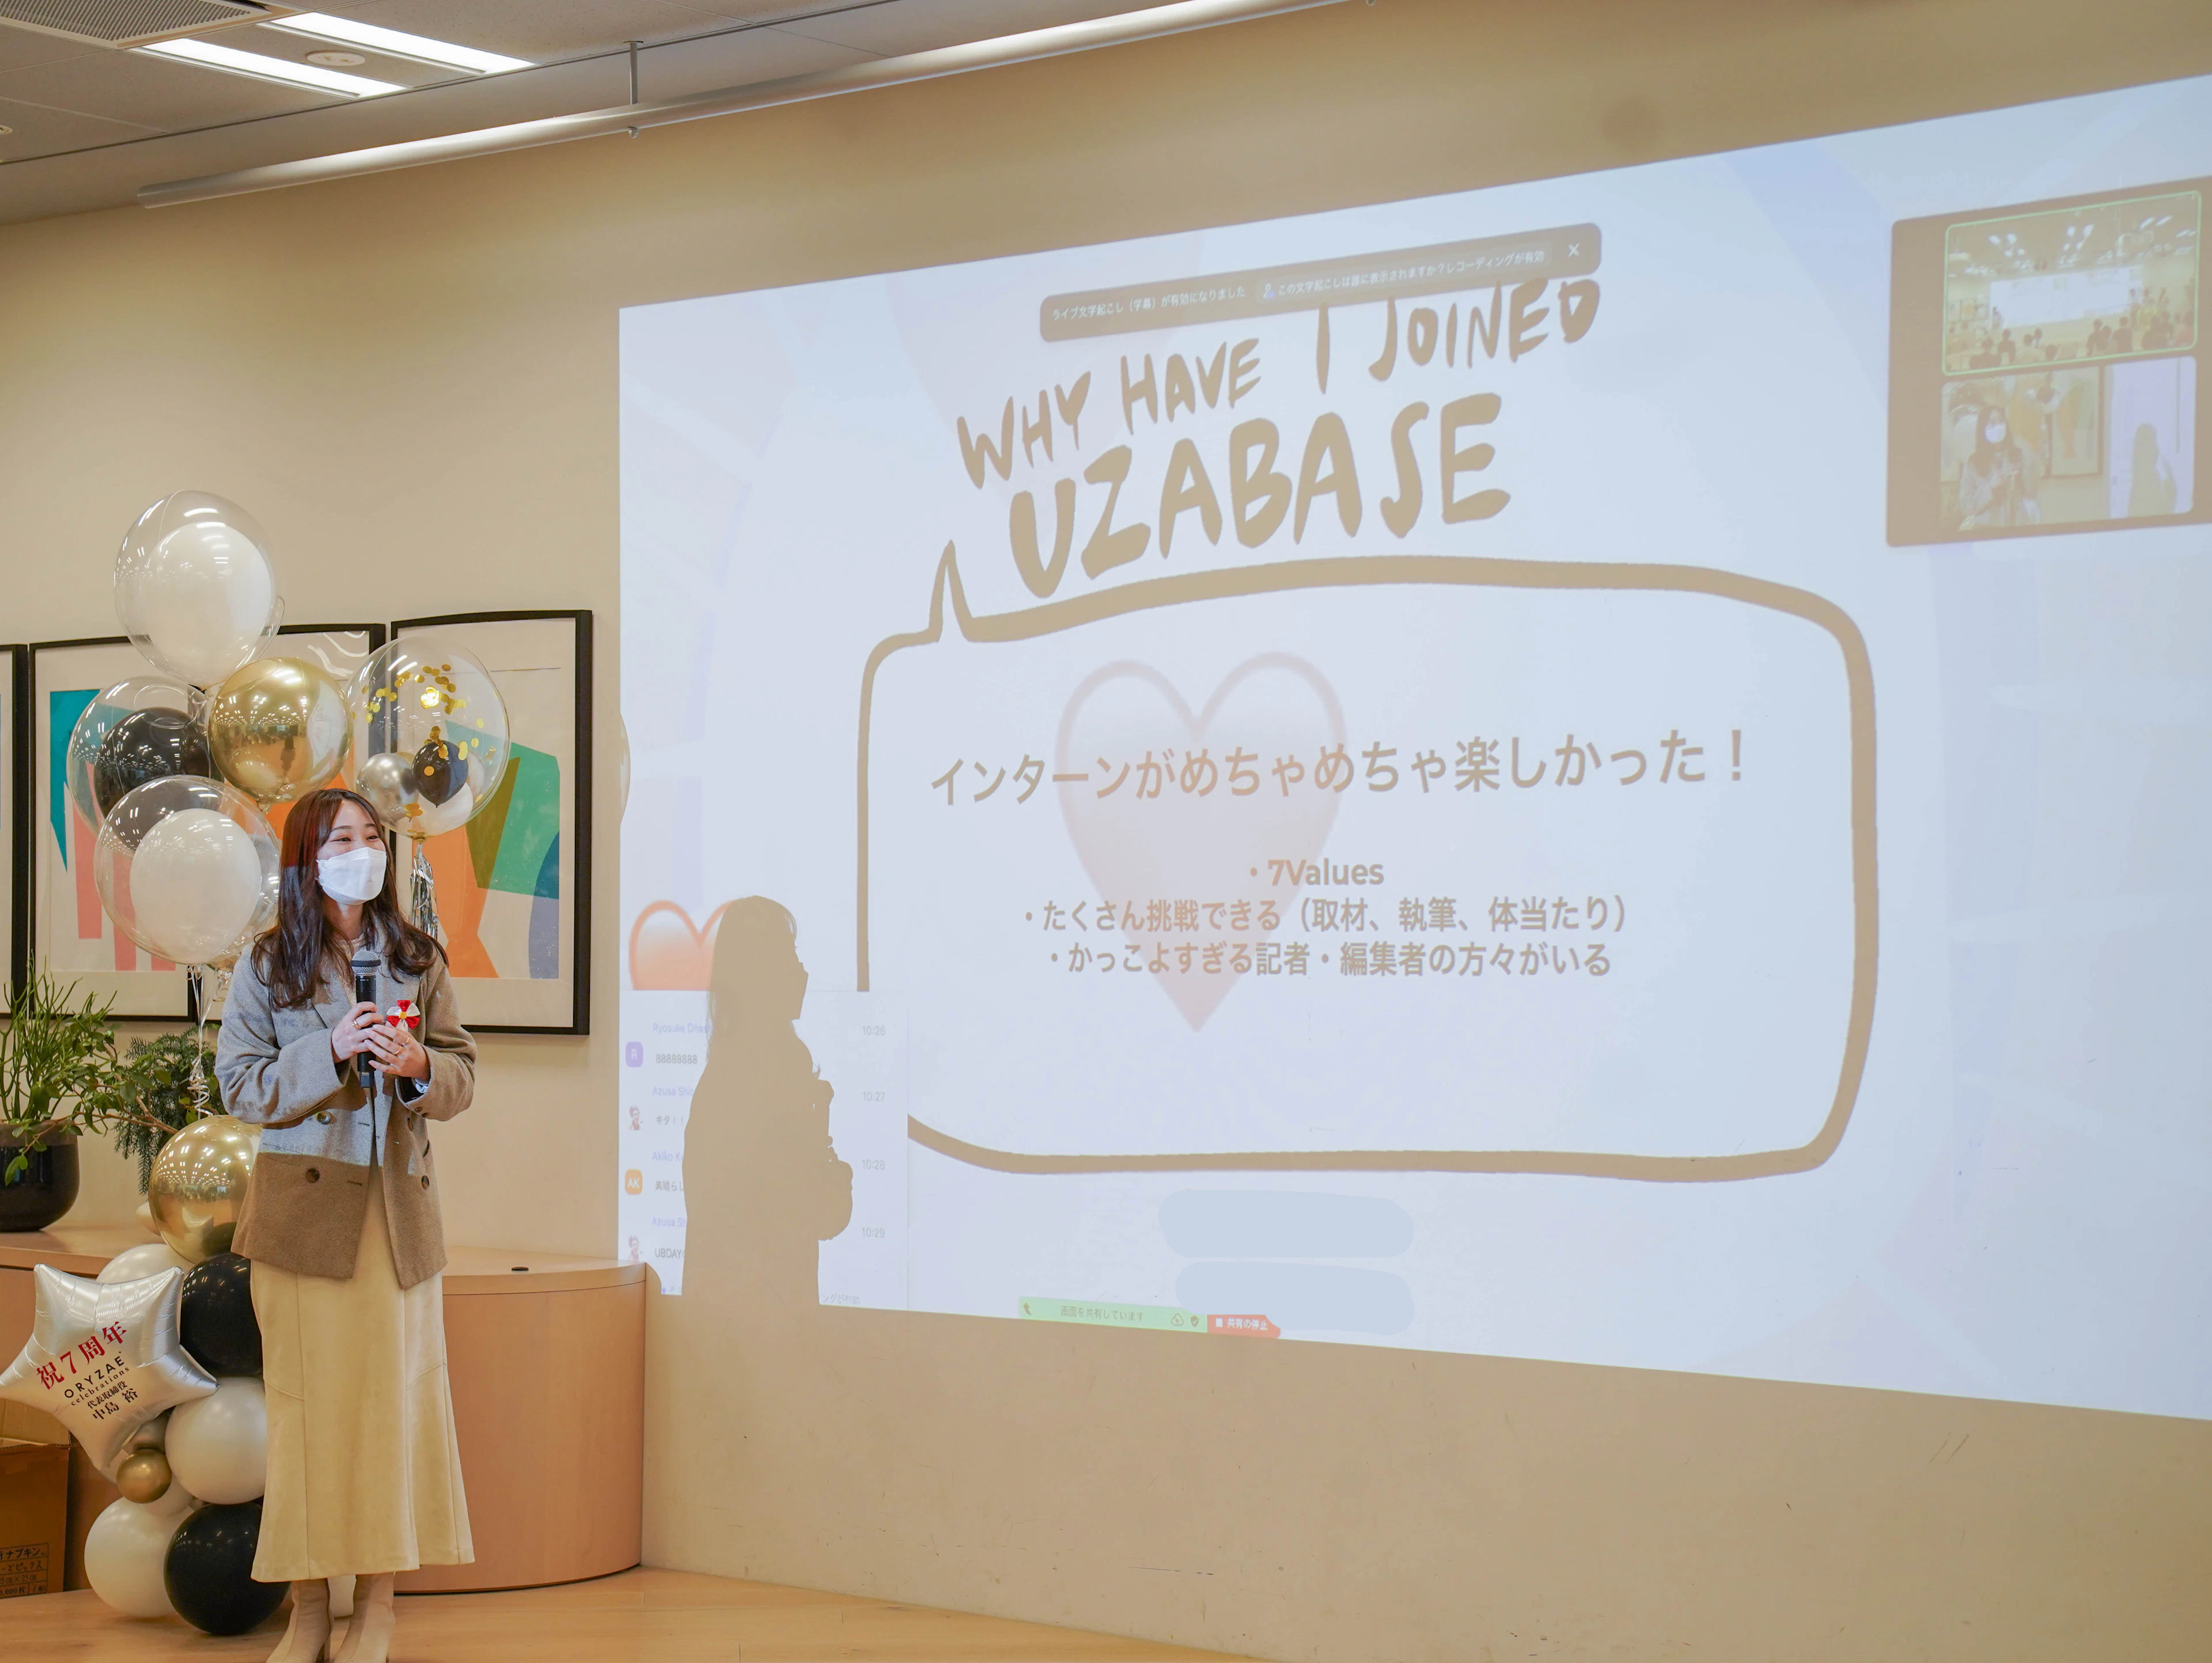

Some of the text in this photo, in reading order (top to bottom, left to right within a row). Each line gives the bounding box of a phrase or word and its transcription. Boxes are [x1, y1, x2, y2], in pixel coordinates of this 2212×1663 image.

[956, 371, 1092, 489] WHY
[1120, 338, 1262, 435] HAVE
[1368, 278, 1600, 382] JOINED
[1009, 392, 1512, 598] UZABASE
[930, 728, 1744, 805] インターンがめちゃめちゃ楽しかった！
[862, 1025, 886, 1036] 10:26
[863, 1091, 885, 1101] 10:27
[862, 1159, 885, 1170] 10:28
[627, 1177, 641, 1188] AK
[862, 1228, 885, 1238] 10:29
[1060, 1305, 1144, 1321] 画面を共有しています
[64, 1355, 124, 1399] ORYZAE
[71, 1366, 130, 1406] celebrations
[87, 1381, 128, 1409] 代表取締役
